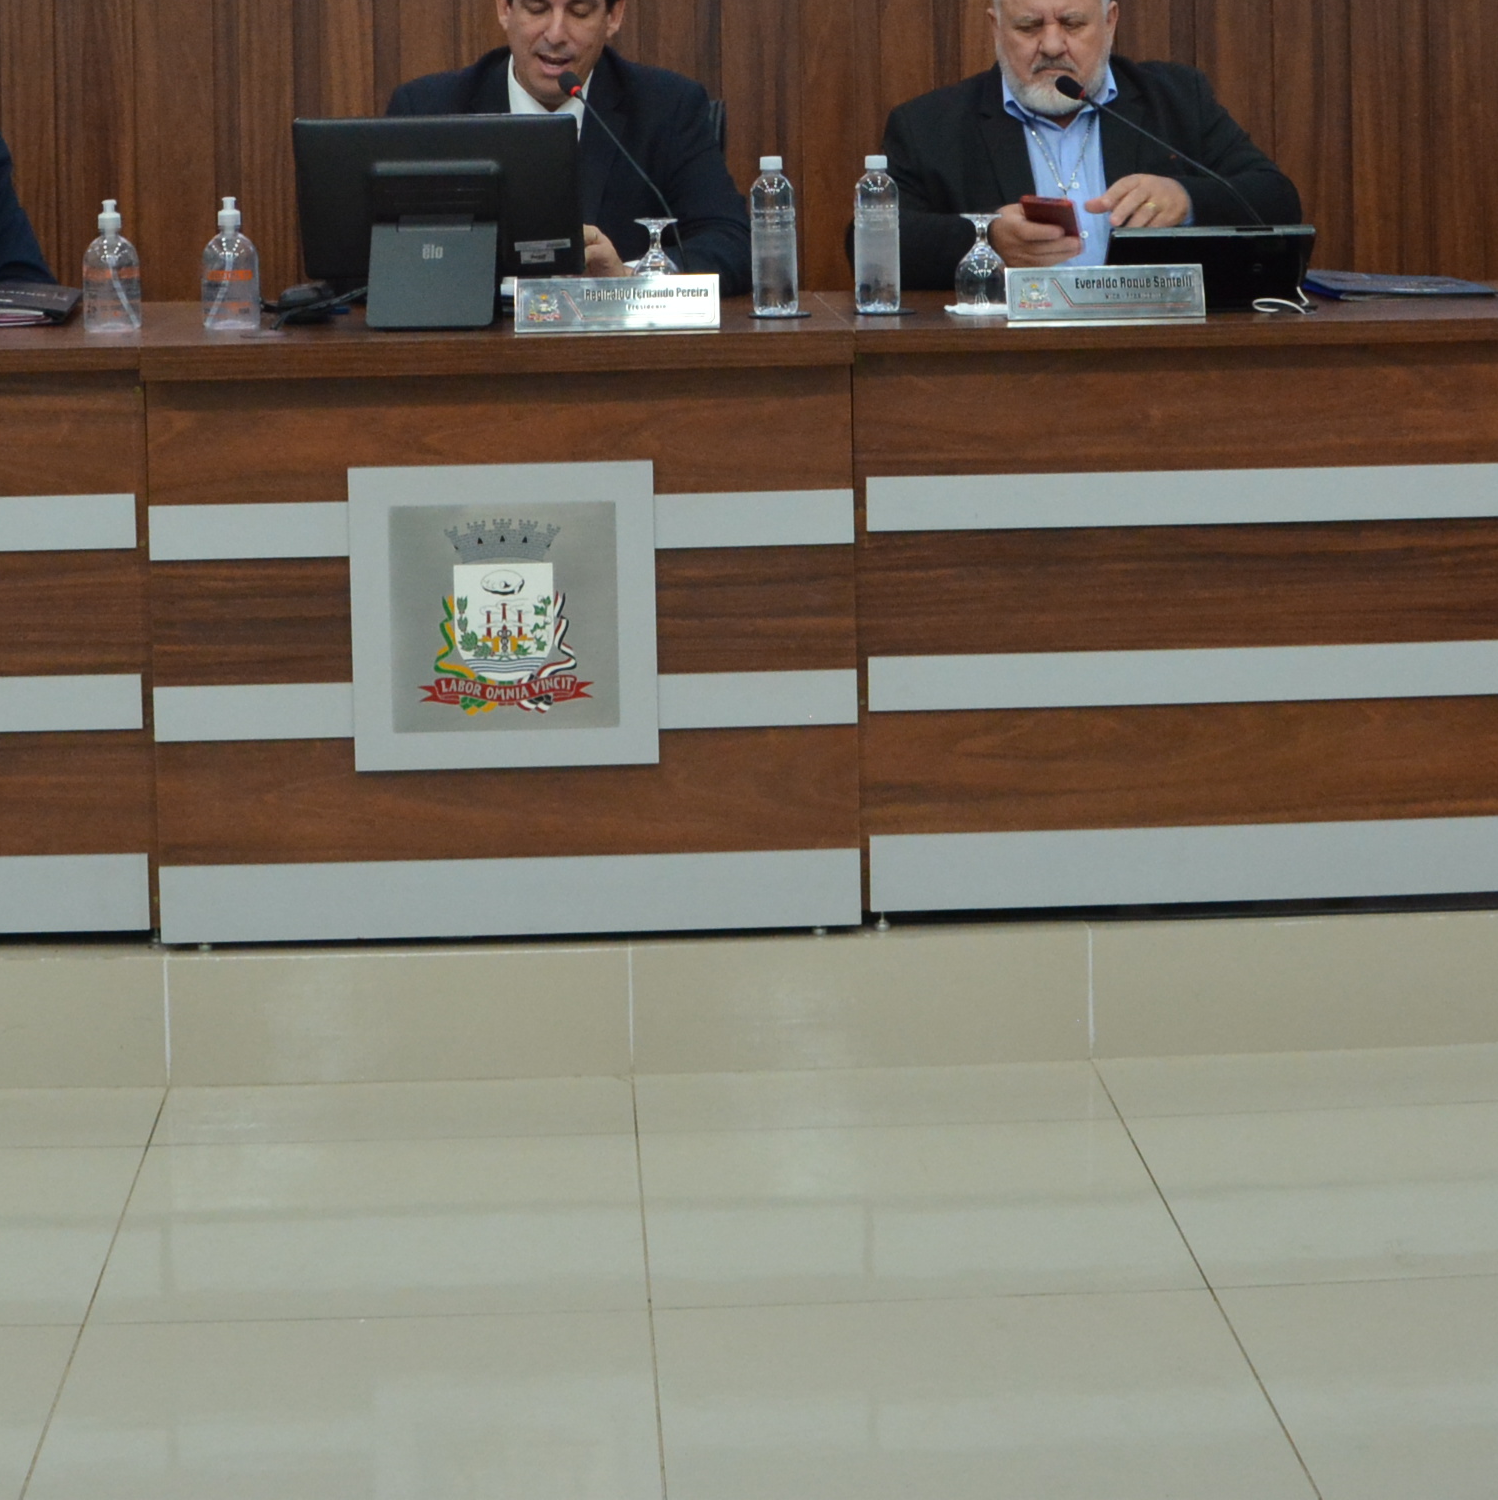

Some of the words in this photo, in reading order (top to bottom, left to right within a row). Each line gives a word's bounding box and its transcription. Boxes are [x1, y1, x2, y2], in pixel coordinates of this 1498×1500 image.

[1074, 276, 1118, 290] Everaldo
[1120, 276, 1153, 290] Roque
[1153, 274, 1193, 288] Santelli
[584, 287, 631, 302] Reginaldo
[632, 286, 675, 300] Fernando
[675, 285, 710, 298] Pereira
[441, 679, 482, 697] LABOR
[485, 686, 530, 701] OMNIA
[530, 676, 576, 694] VINCIT
